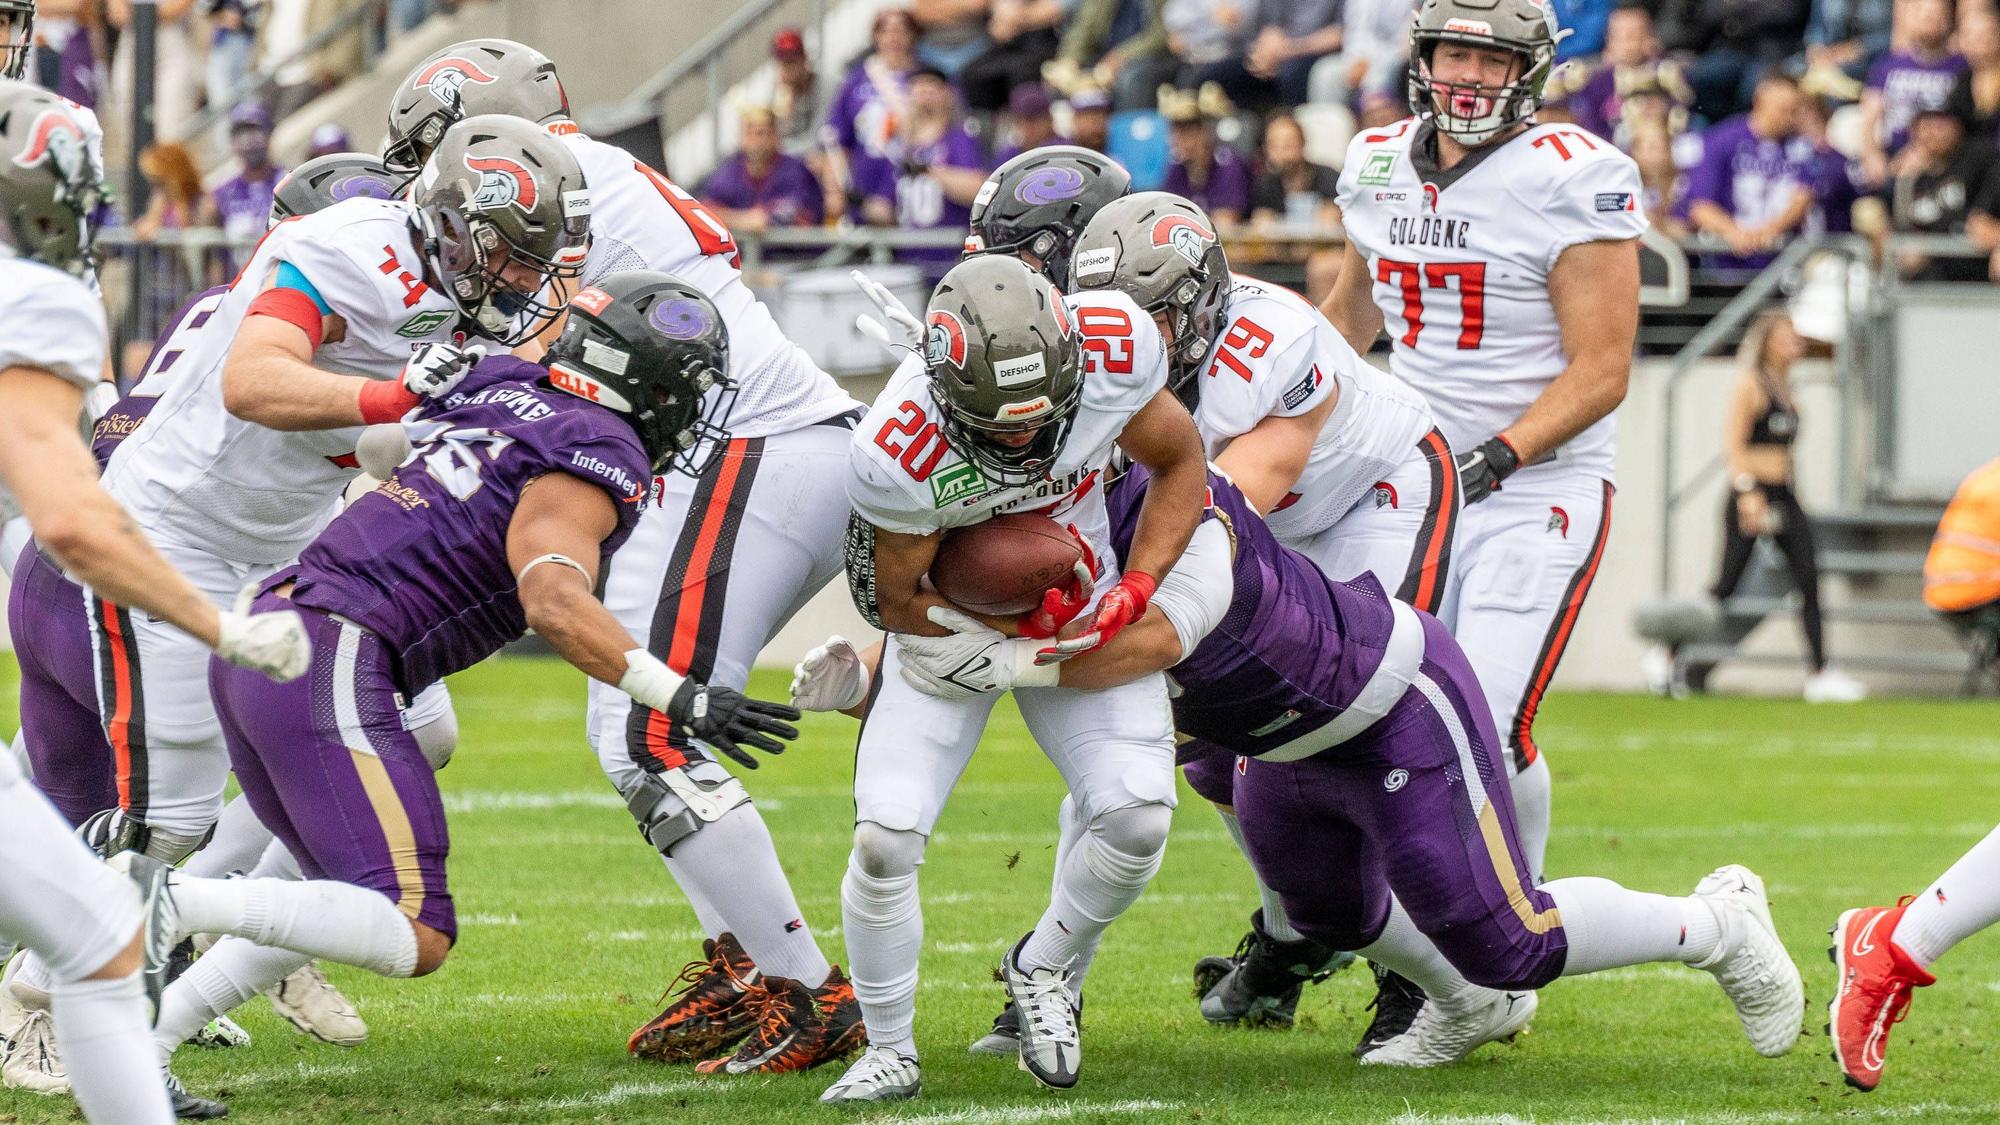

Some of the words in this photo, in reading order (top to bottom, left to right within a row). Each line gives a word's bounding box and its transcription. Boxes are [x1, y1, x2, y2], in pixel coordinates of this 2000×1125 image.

[1078, 256, 1111, 269] DEFSHOP
[1389, 217, 1470, 249] COLOGNE
[378, 244, 429, 309] 74
[1377, 257, 1487, 350] 77
[1077, 306, 1134, 375] 20
[1175, 312, 1190, 341] iddell
[1207, 316, 1275, 384] 79
[1000, 362, 1041, 378] DEFSHOP
[873, 399, 950, 483] 20
